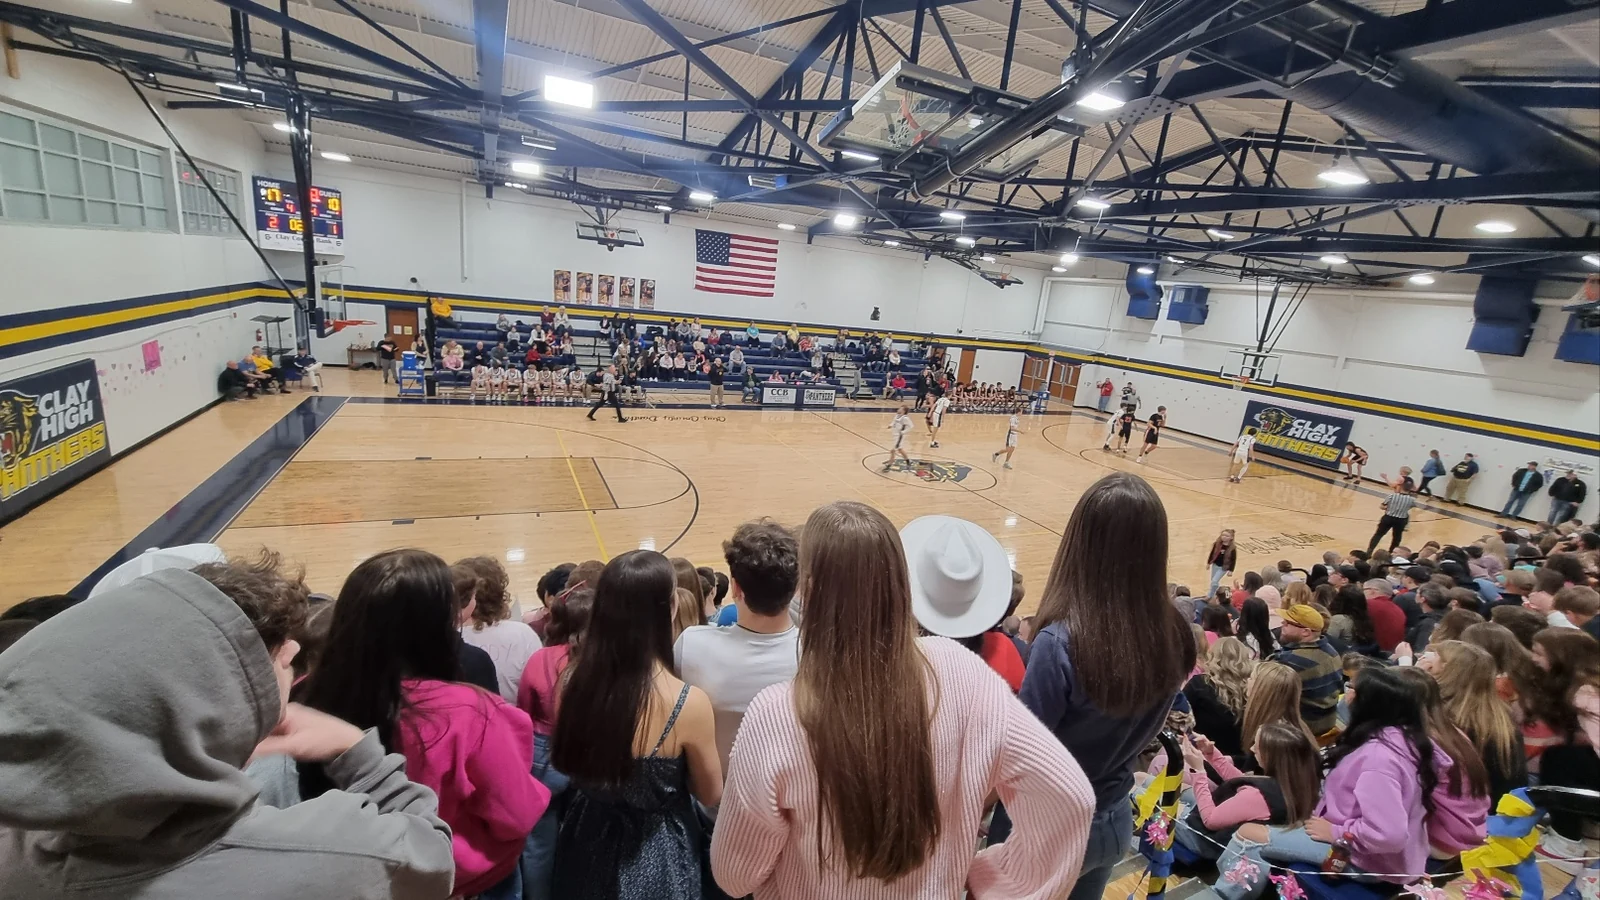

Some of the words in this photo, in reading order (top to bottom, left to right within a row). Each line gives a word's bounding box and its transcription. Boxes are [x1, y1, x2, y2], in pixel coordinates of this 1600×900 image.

[257, 180, 280, 188] HOME
[319, 190, 341, 199] GUEST
[328, 198, 340, 211] 10
[39, 380, 91, 417] CLAY
[770, 388, 789, 396] CCB
[41, 400, 94, 442] HIGH
[1292, 419, 1342, 435] CLAY
[1287, 427, 1338, 446] HIGH
[0, 421, 106, 502] ANTHERS
